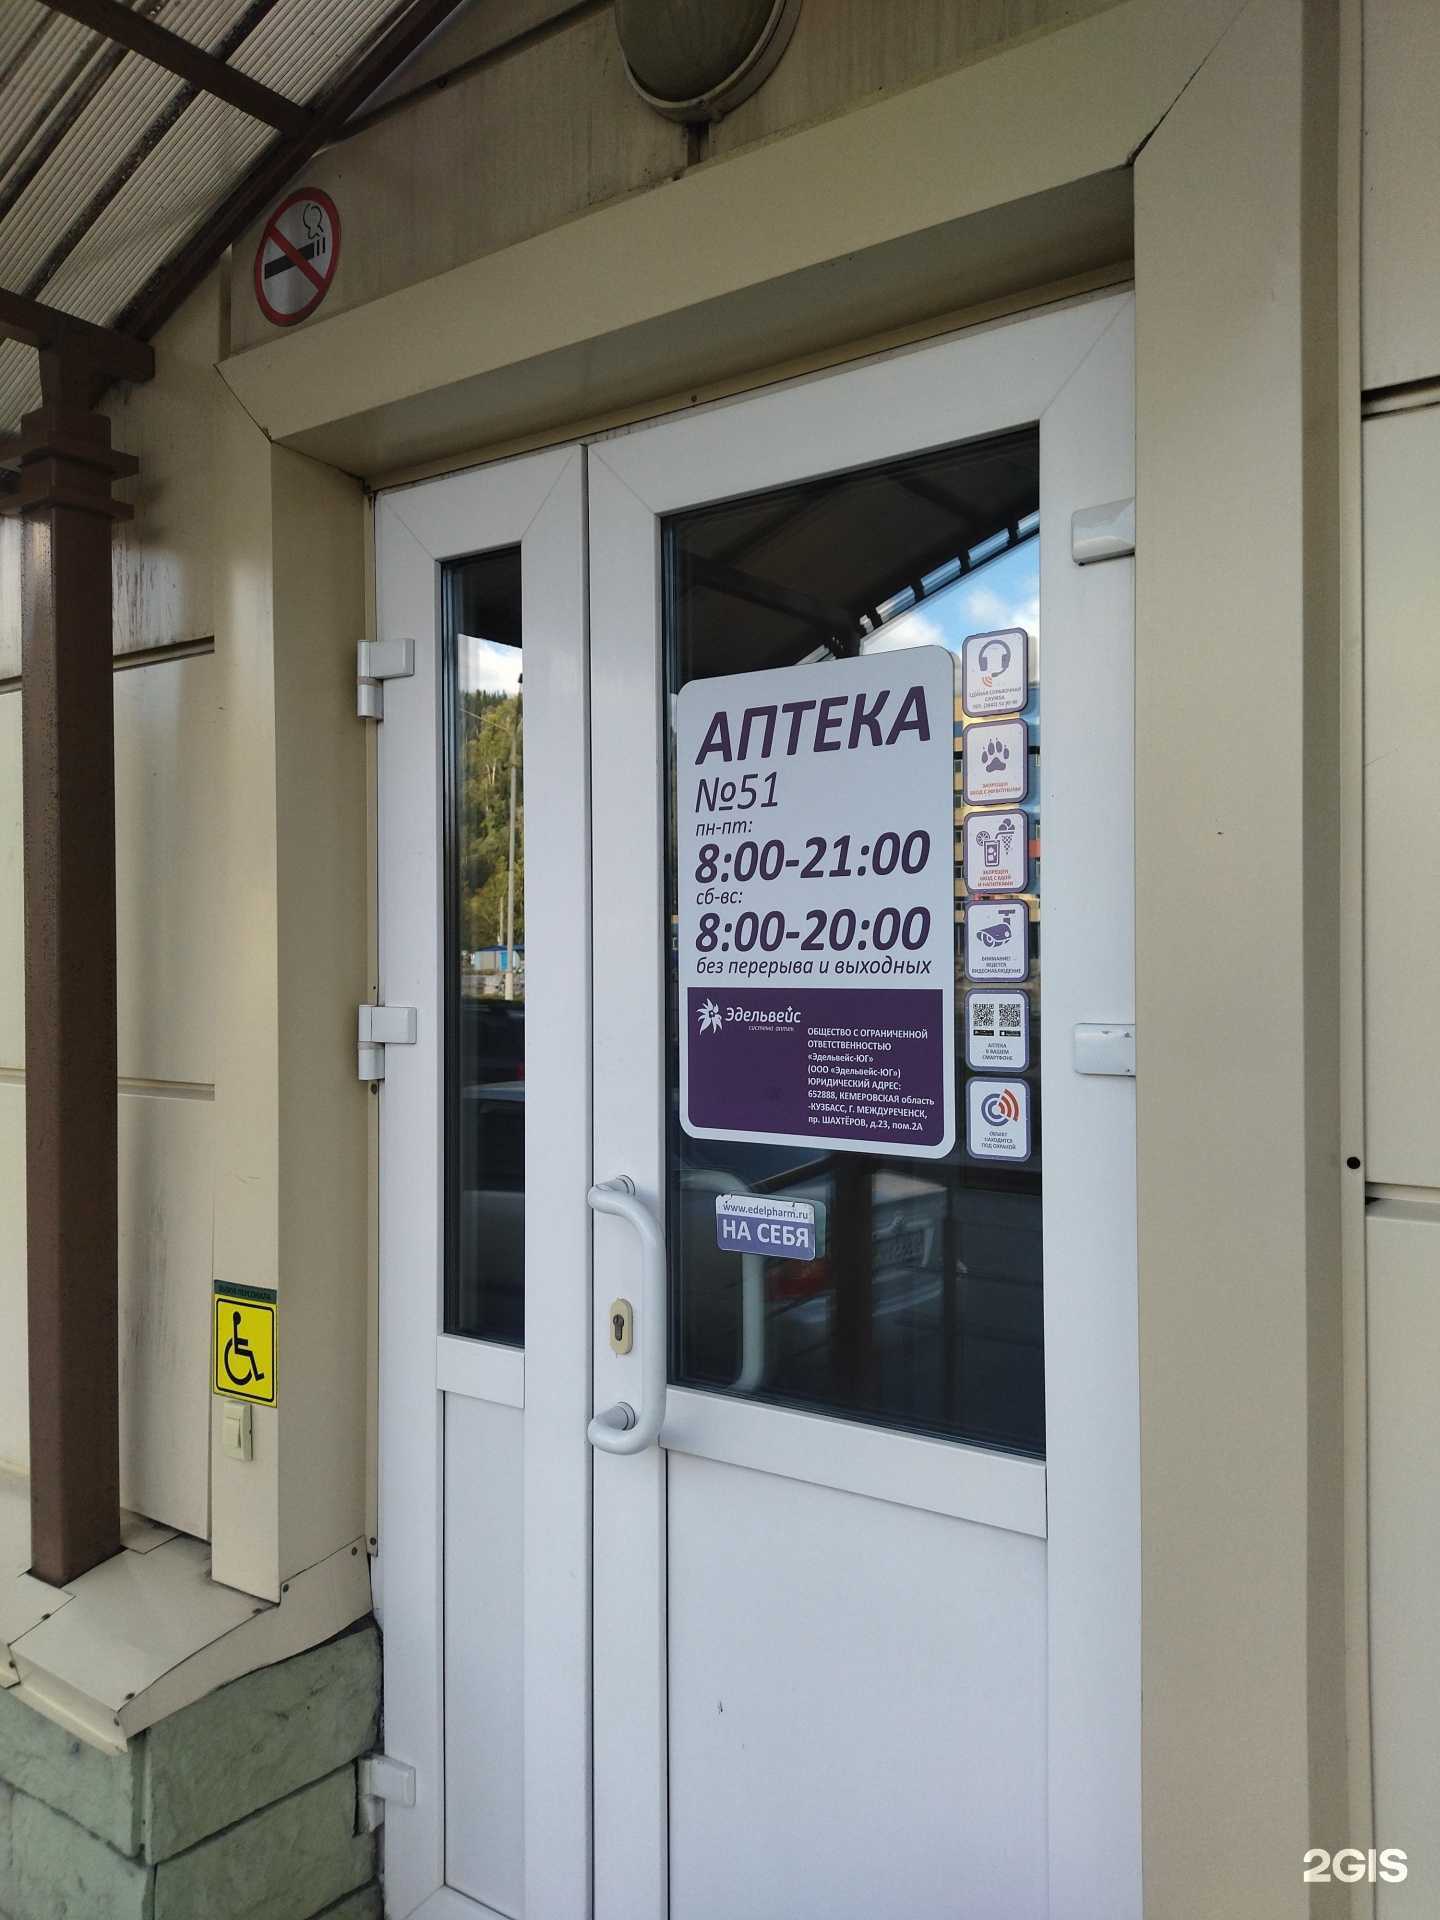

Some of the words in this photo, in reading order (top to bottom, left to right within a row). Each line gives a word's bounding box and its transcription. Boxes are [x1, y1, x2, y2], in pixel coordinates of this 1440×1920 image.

[695, 685, 931, 765] АПТЕКА
[695, 771, 779, 813] №51
[696, 819, 752, 836] пн-пт:
[695, 829, 931, 883] 8:00-21:00
[696, 888, 743, 905] сб-вс:
[695, 906, 931, 953] 8:00-20:00
[696, 957, 723, 974] без
[728, 960, 813, 982] перерыва
[820, 960, 829, 974] и
[835, 956, 931, 975] выходных
[726, 1006, 801, 1023] Эдельвейс
[808, 1028, 851, 1036] ОБЩЕСТВО
[861, 1028, 928, 1039] ОГРАНИЧЕННОЙ
[808, 1040, 891, 1050] ОТВЕТСТВЕННОСТЬЮ
[808, 1053, 873, 1063] «Эдельвейс-ЮГ»
[808, 1065, 828, 1074] (ООО
[831, 1067, 901, 1078] «Эдельвейс-ЮГ»)
[808, 1078, 869, 1088] ЮРИДИЧЕСКИЙ
[872, 1082, 901, 1091] АДРЕС:
[840, 1092, 899, 1103] КЕМЕРОВСКАЯ
[902, 1096, 935, 1105] область
[808, 1103, 846, 1113] -КУЗБАСС,
[857, 1106, 928, 1119] МЕЖДУРЕЧЕНСК,
[822, 1116, 868, 1128] ШАХТЁРОВ,
[870, 1121, 890, 1129] д.23,
[723, 1204, 808, 1219] www.edelpharm.ru
[722, 1219, 751, 1240] НА
[757, 1223, 808, 1248] СЕБЯ
